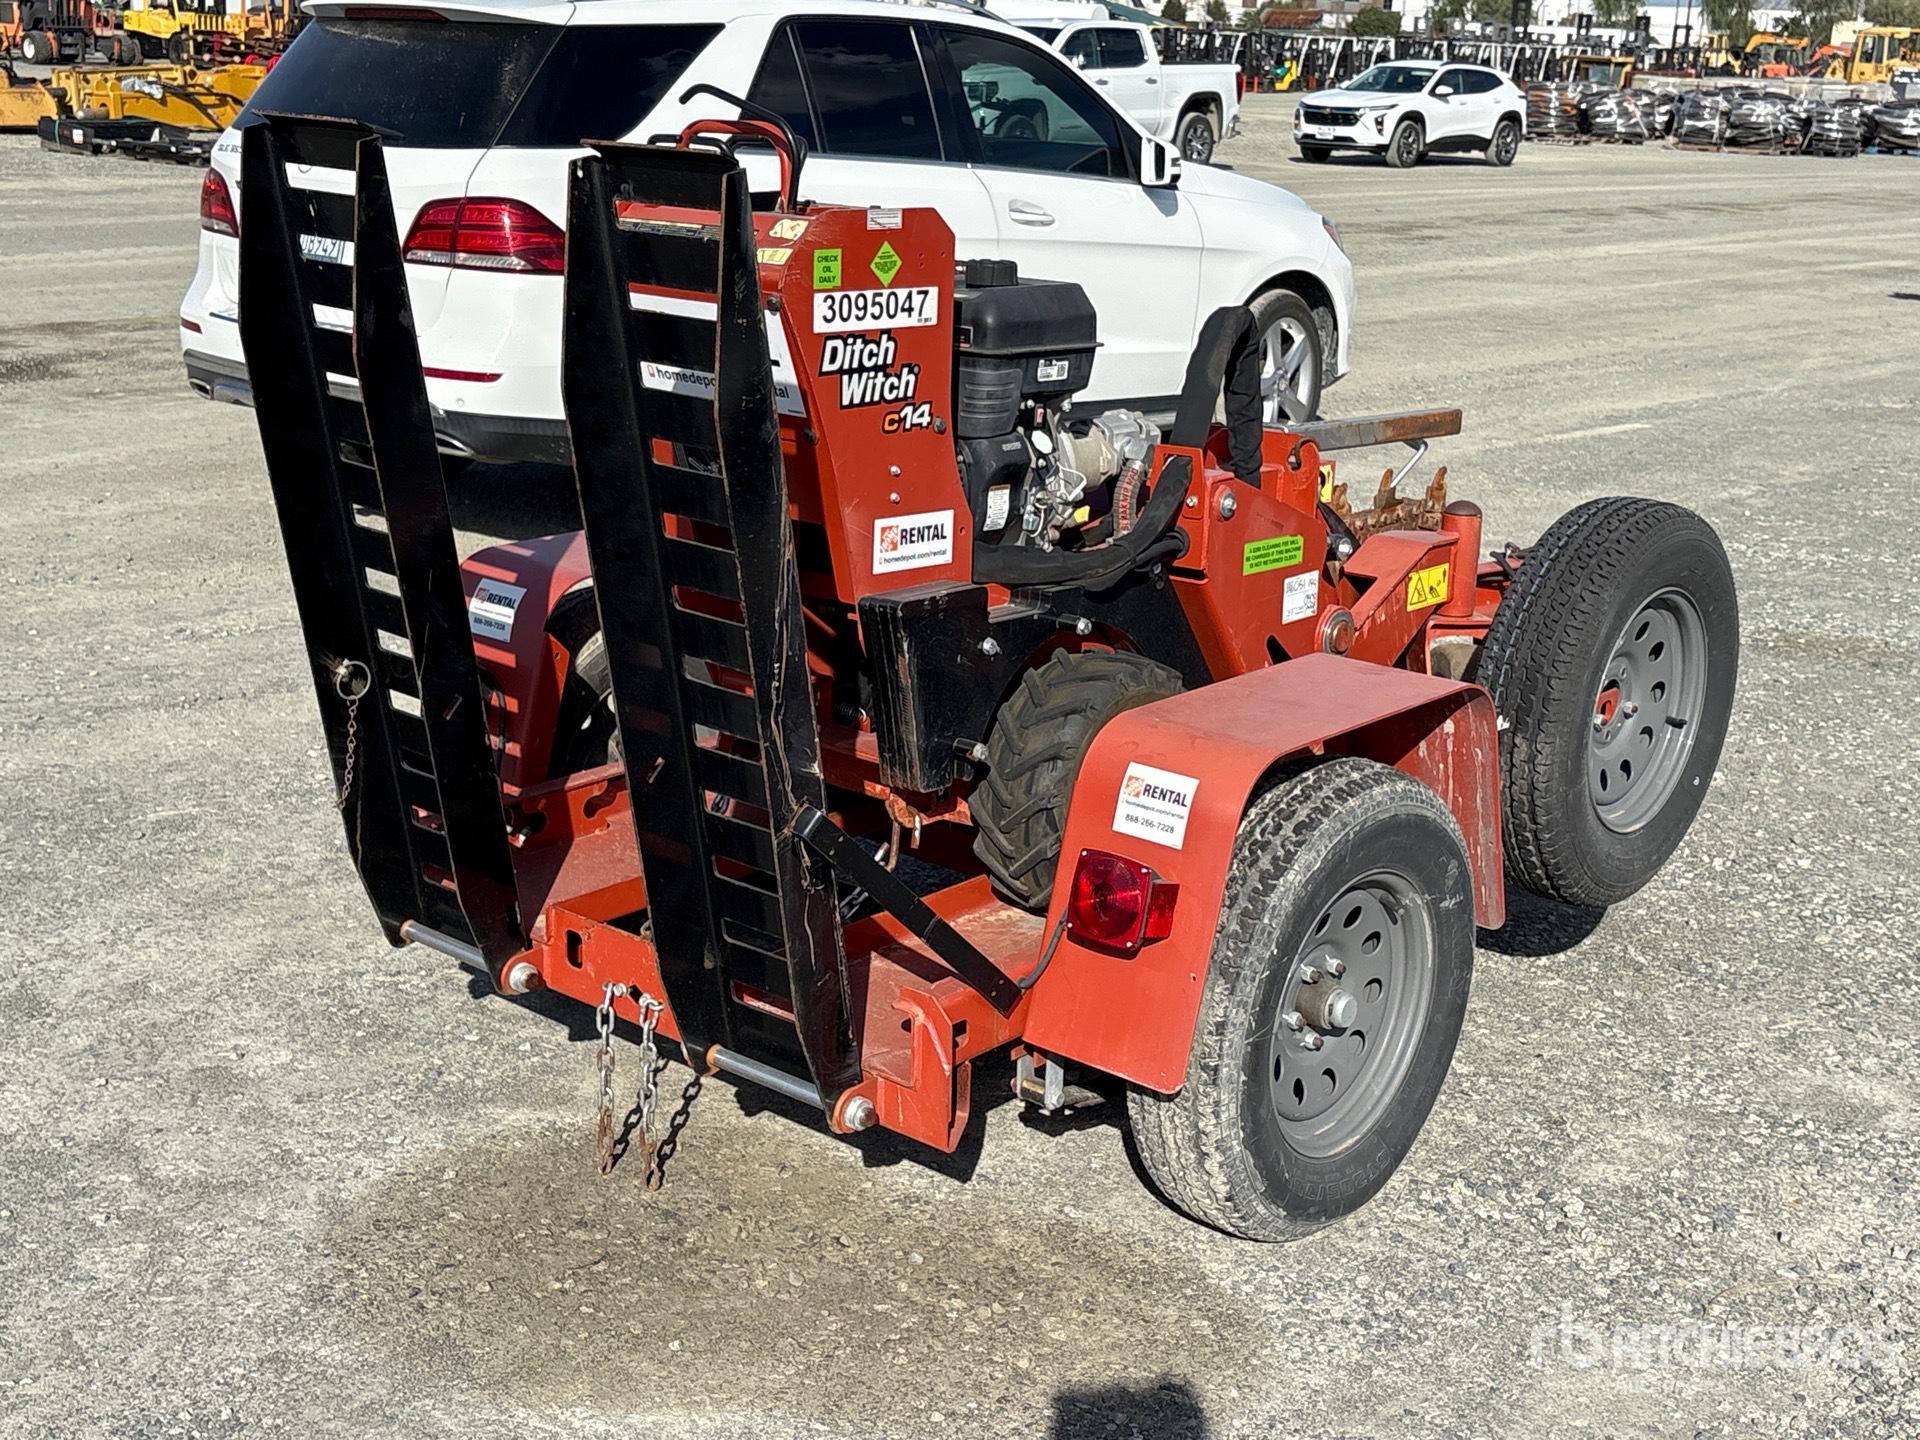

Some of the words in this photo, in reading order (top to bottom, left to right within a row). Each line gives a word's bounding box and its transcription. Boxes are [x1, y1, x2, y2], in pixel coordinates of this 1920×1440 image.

[817, 254, 839, 263] CHECK
[818, 275, 836, 284] DAILY
[822, 265, 833, 274] OIL
[822, 289, 930, 324] 3095047
[820, 332, 897, 374] Ditch
[655, 366, 716, 389] homedepo
[773, 386, 790, 399] tal
[840, 365, 918, 408] Witch
[1128, 468, 1140, 486] MAD
[899, 522, 948, 546] RENTAL
[883, 548, 947, 565] homedepot.com/rental
[486, 592, 516, 610] RENTAL
[1142, 783, 1188, 808] RENTAL
[1124, 813, 1175, 834] 888-266-7228
